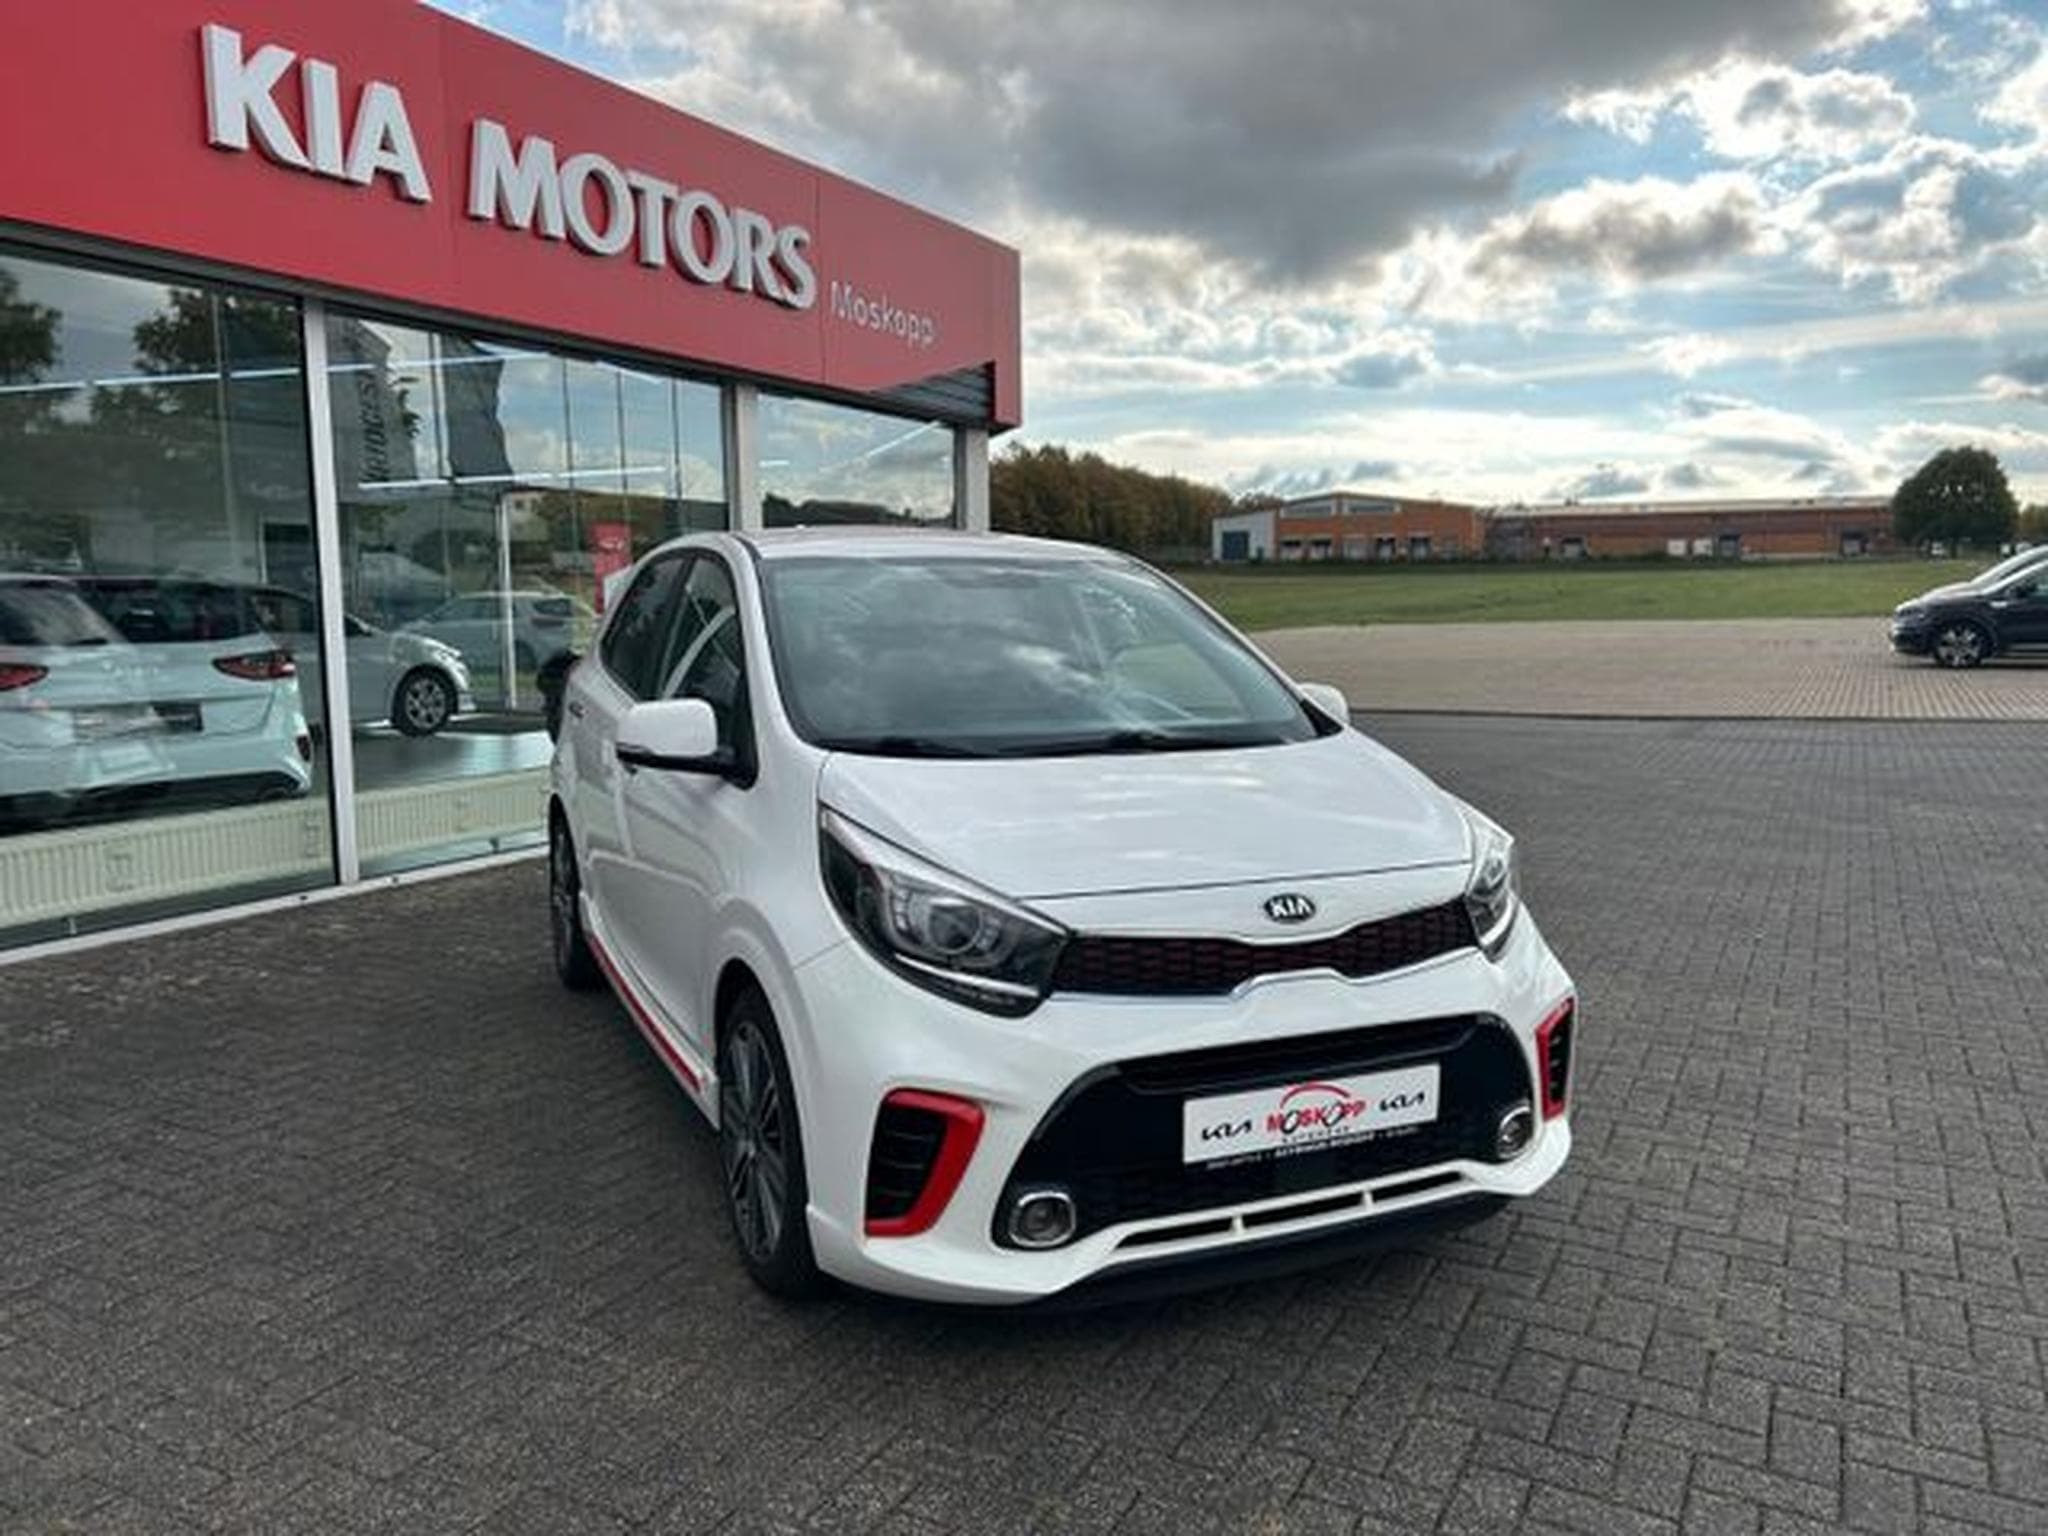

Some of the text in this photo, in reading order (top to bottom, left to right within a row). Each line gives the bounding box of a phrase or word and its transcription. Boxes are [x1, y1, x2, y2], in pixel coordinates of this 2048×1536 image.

[202, 23, 819, 310] KIA MOTORS
[831, 279, 937, 347] Moskopp
[1268, 897, 1314, 919] KIA
[1265, 1100, 1367, 1135] MOSKOPP
